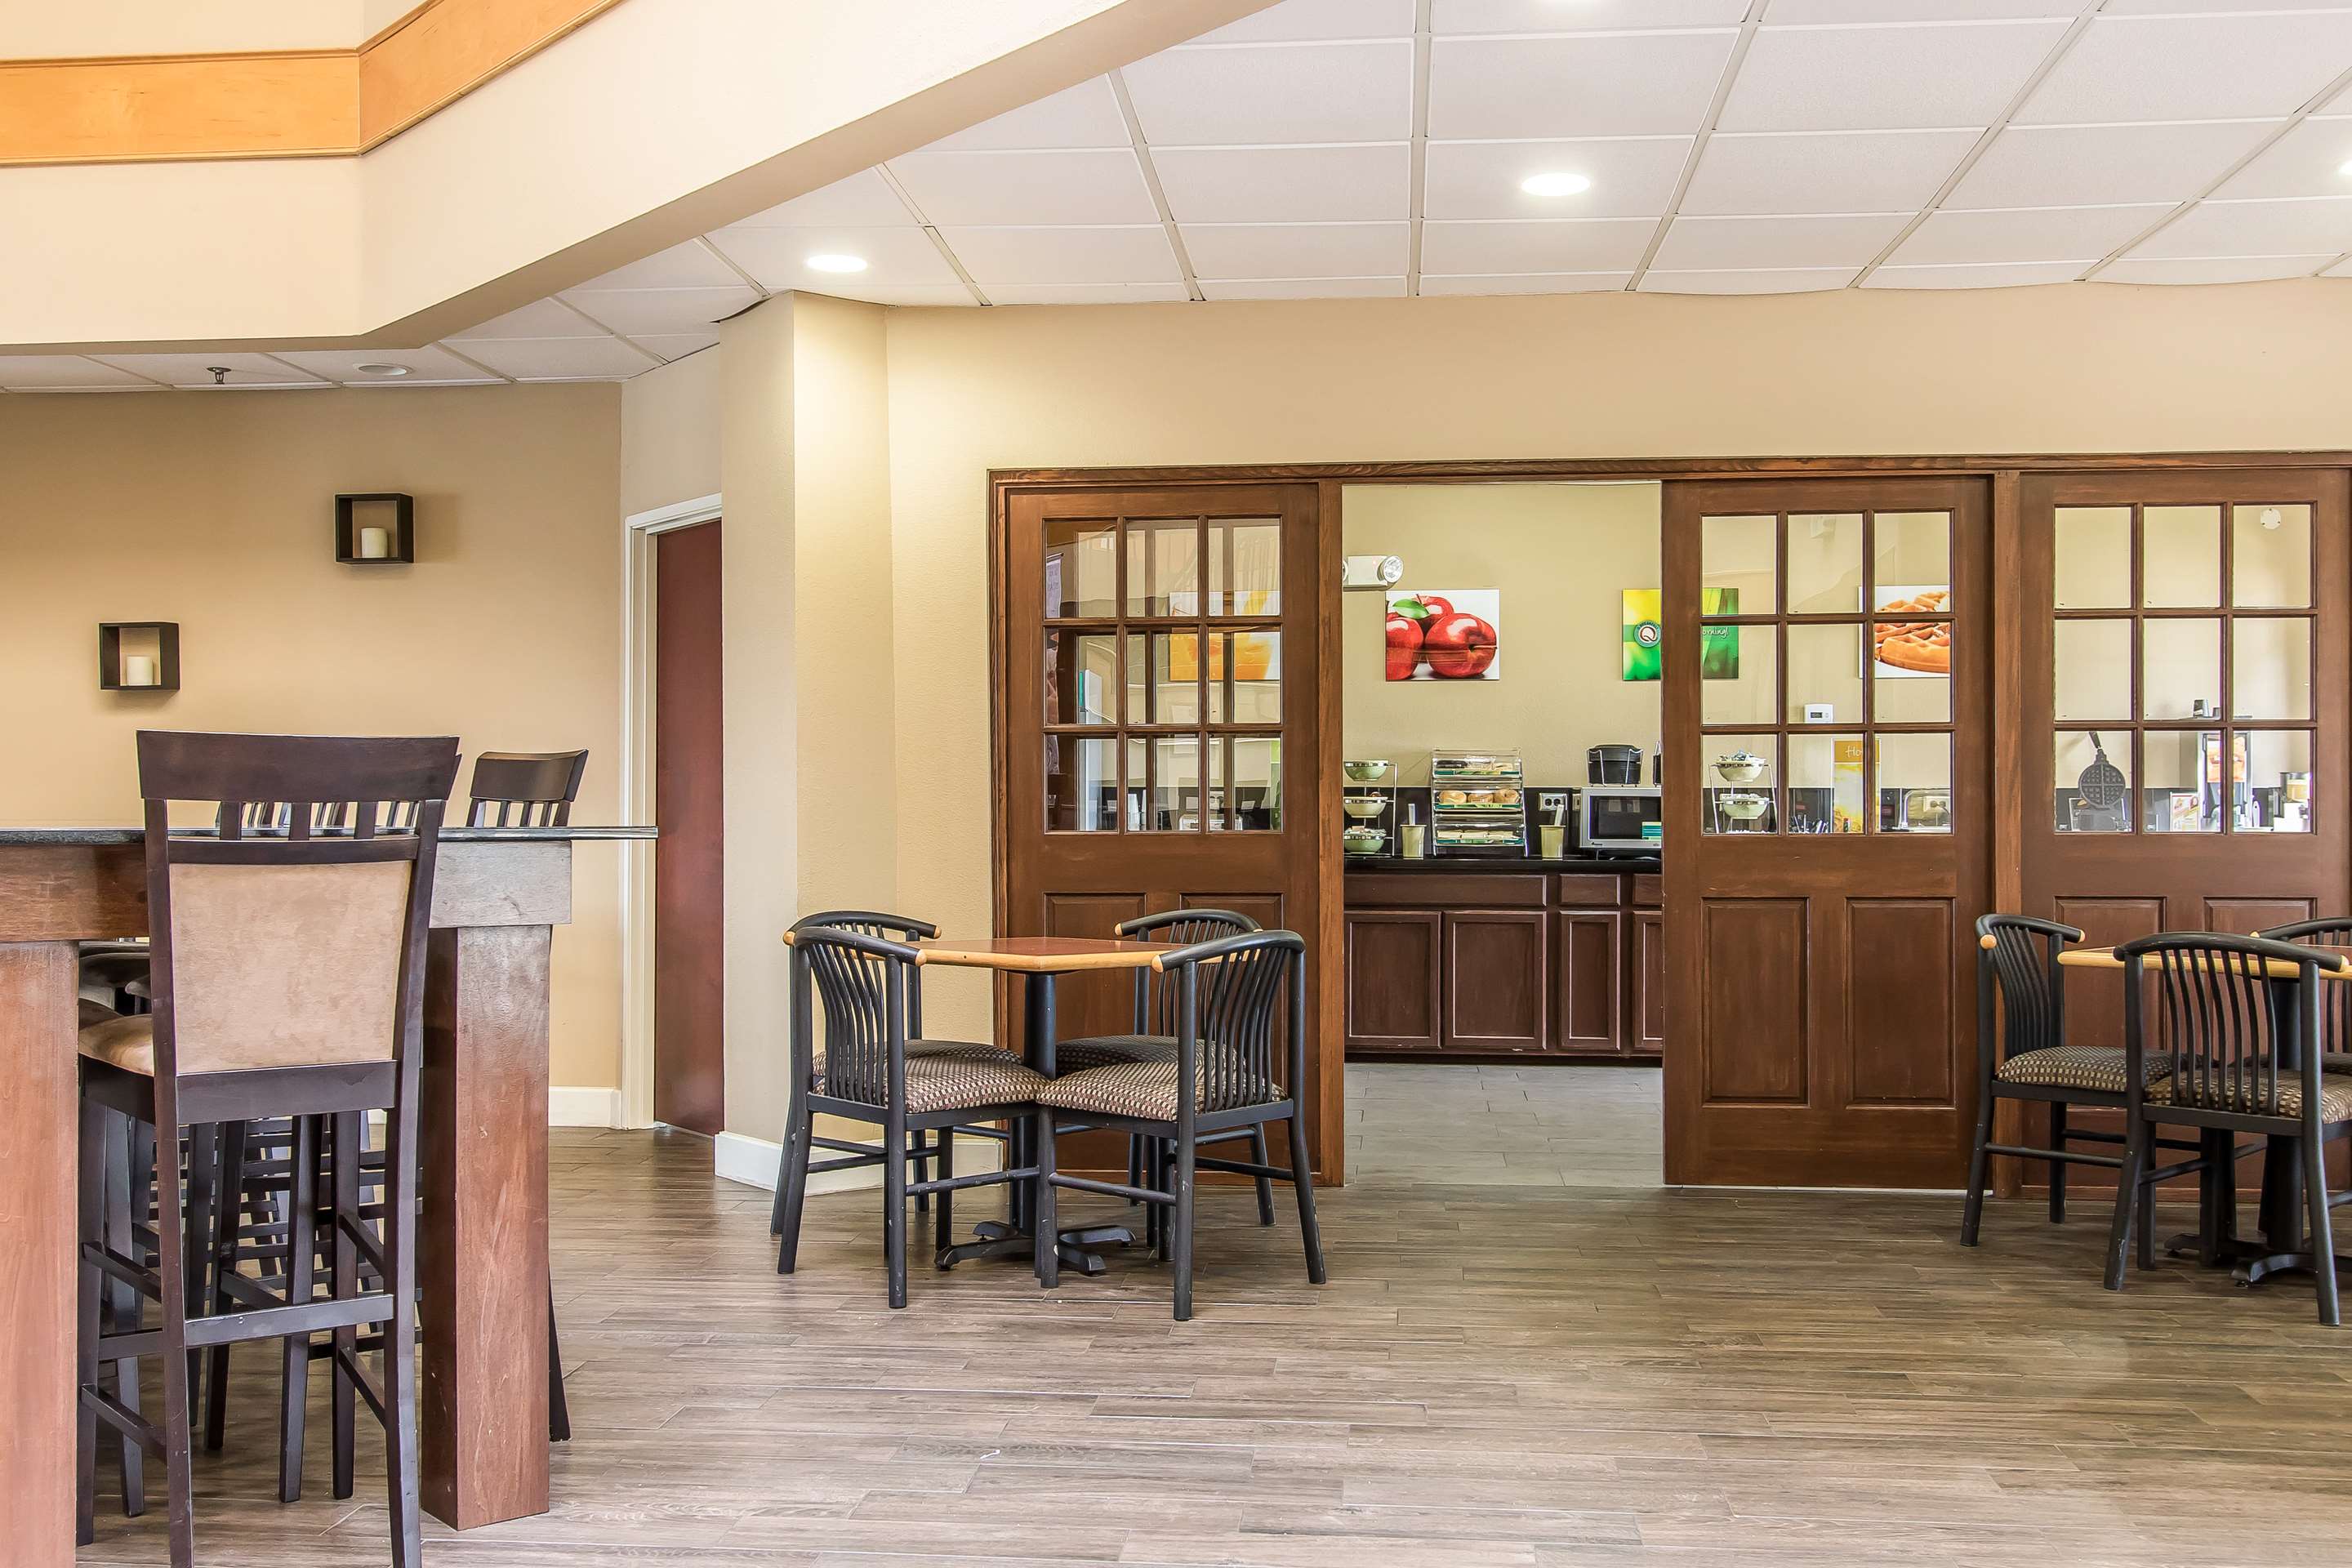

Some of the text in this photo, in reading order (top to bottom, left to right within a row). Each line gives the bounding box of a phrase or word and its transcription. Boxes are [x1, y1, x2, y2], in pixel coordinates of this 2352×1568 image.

[1640, 626, 1658, 642] Q
[1702, 626, 1729, 639] orning!
[1845, 746, 1863, 758] Ho
